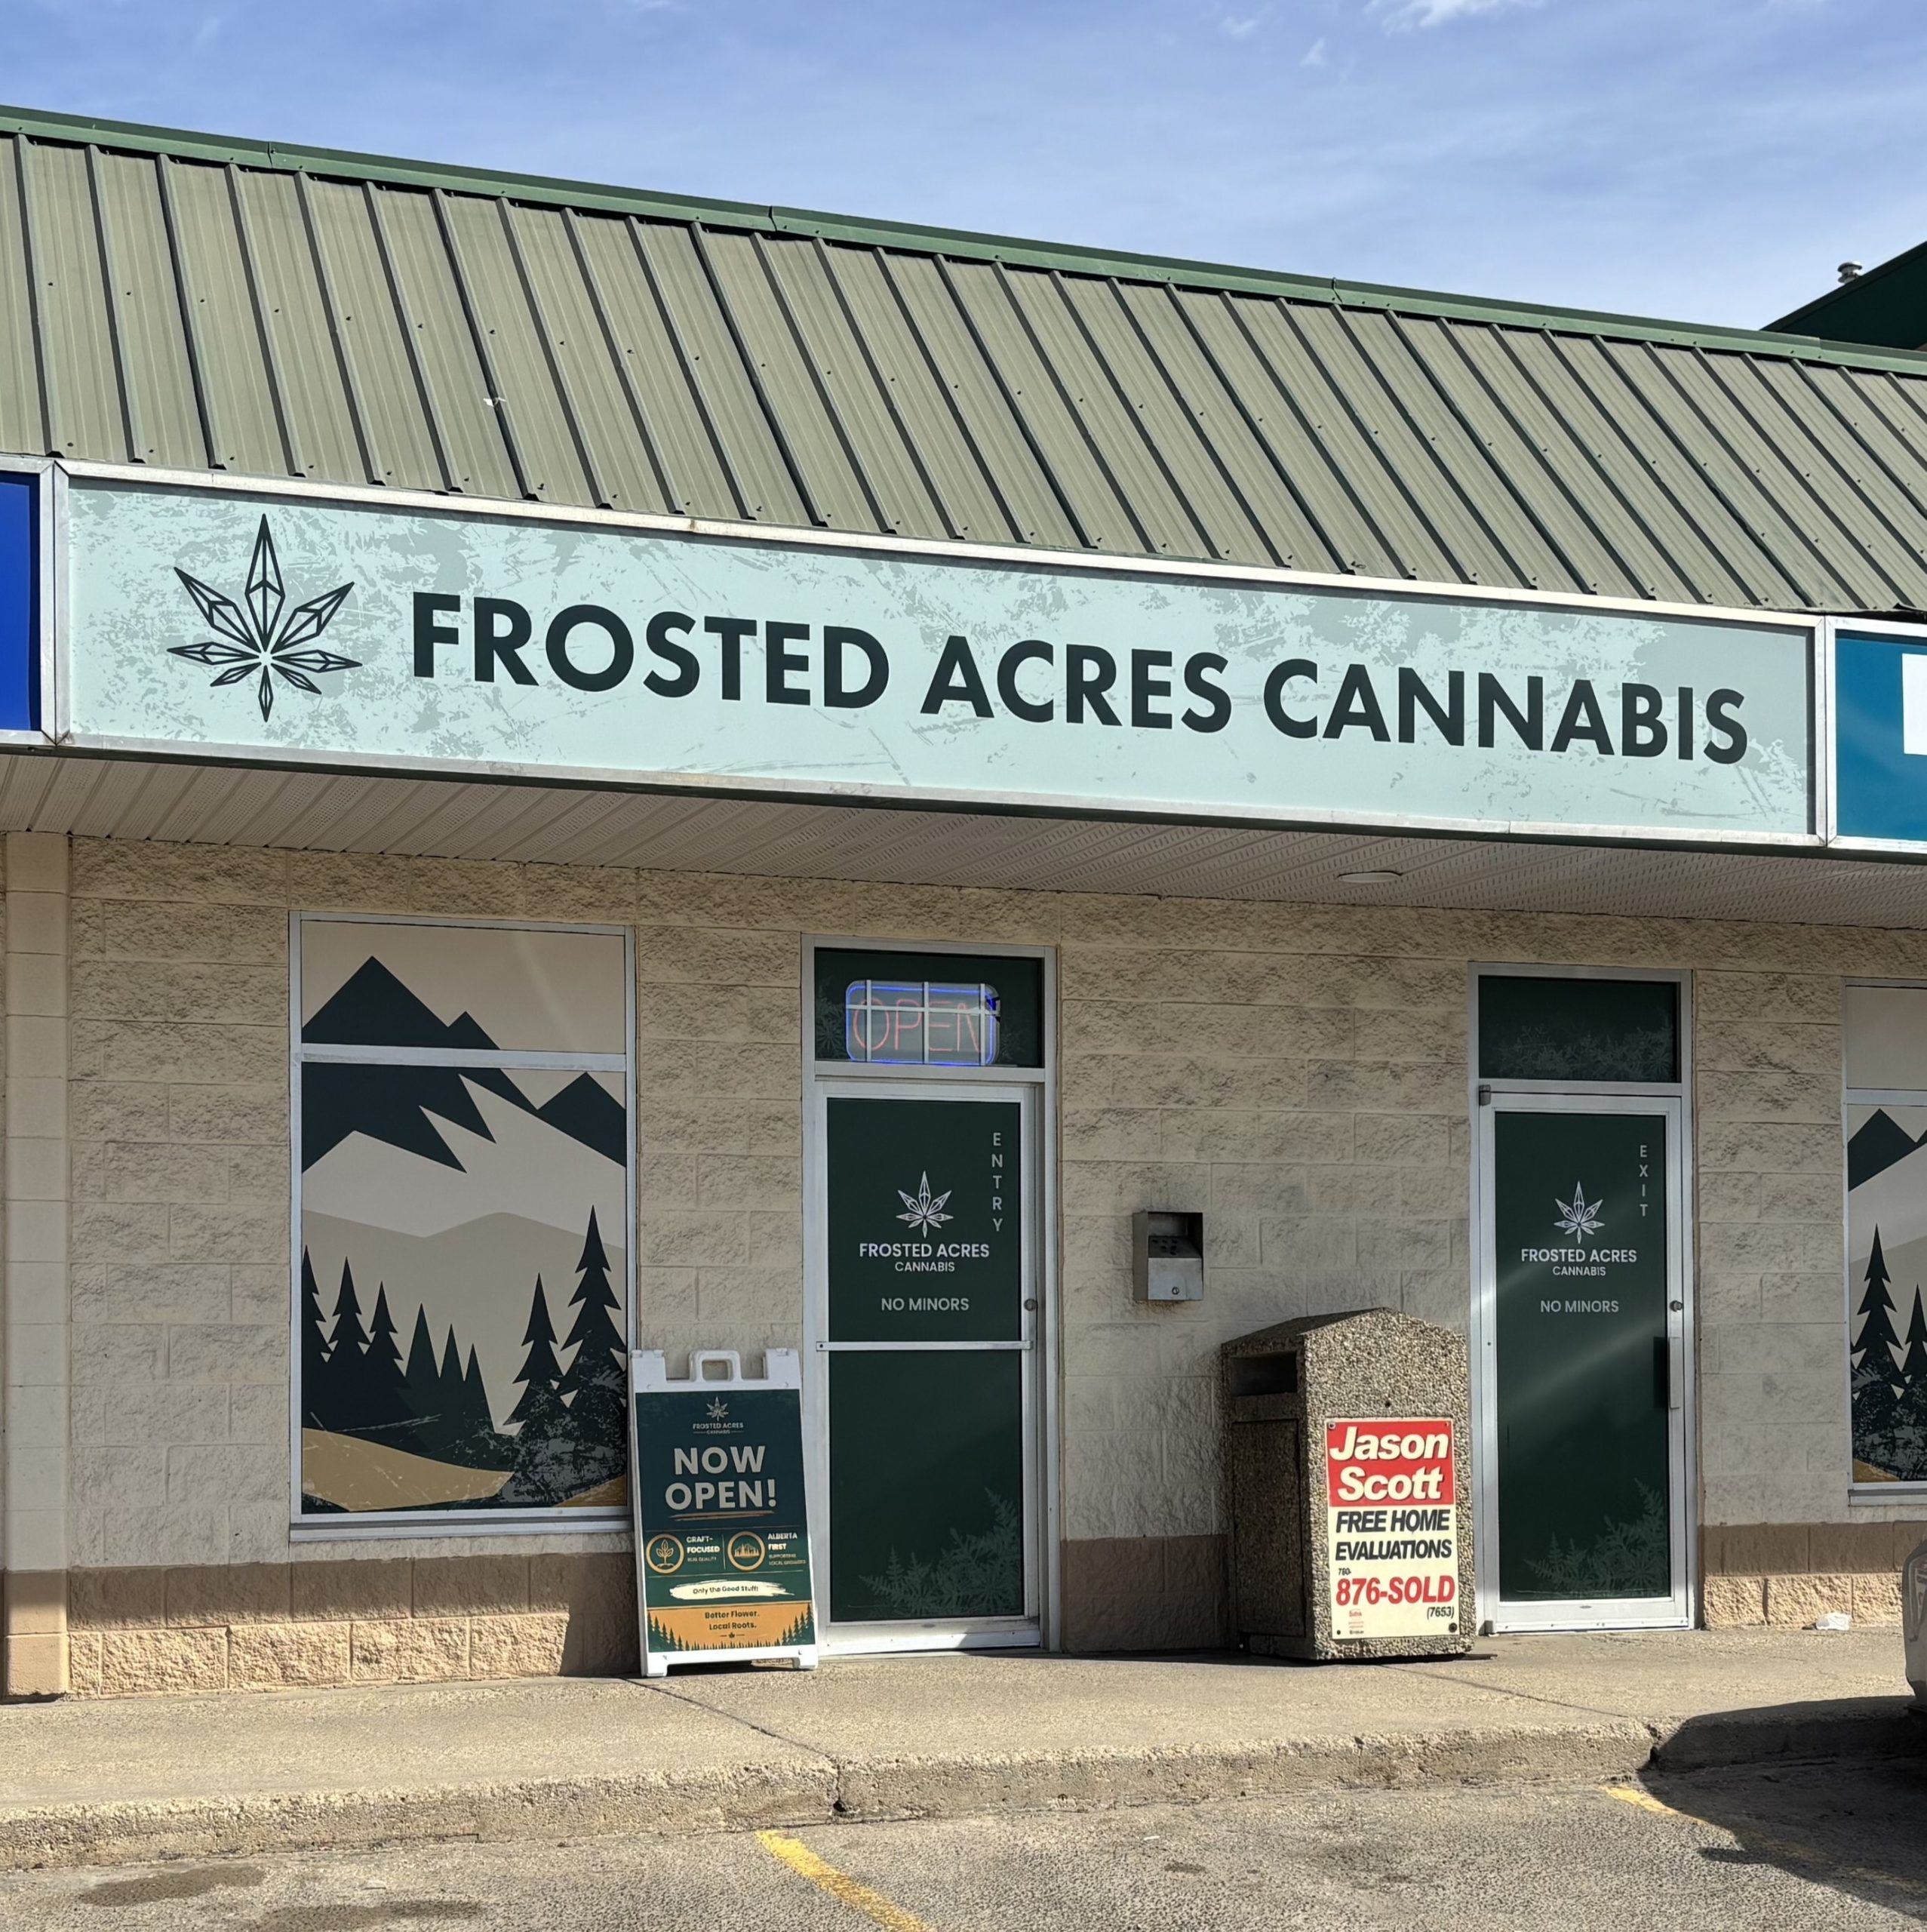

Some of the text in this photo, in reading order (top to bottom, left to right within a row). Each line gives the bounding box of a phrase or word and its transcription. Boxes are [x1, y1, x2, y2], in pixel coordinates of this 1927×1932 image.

[413, 592, 1747, 764] FROSTED ACRES CANNABIS
[853, 998, 982, 1053] OPEN
[991, 1132, 1003, 1232] ENTRY
[1639, 1145, 1648, 1217] EXIT
[859, 1243, 990, 1258] FROSTED ACRES
[1521, 1248, 1637, 1263] FROSTED ACRES
[895, 1261, 955, 1272] CANNABIS
[1552, 1266, 1606, 1276] CANNABIS
[881, 1297, 970, 1311] NO MINORS
[1541, 1300, 1619, 1313] NO MINORS
[1329, 1426, 1449, 1461] Jason
[674, 1445, 766, 1475] NOW
[1337, 1466, 1444, 1501] Scott
[665, 1478, 776, 1510] OPEN!
[1336, 1509, 1451, 1534] FREE HOME
[687, 1535, 713, 1543] CRAFT-
[767, 1532, 798, 1540] ALBERTA
[687, 1545, 721, 1554] FOCUSED
[768, 1543, 787, 1551] FIRST
[1335, 1539, 1452, 1561] EVALUATIONS
[1336, 1575, 1455, 1606] 876-SOLD
[730, 1610, 761, 1618] Flower.
[1427, 1606, 1455, 1620] (7653)
[709, 1621, 758, 1630] Local Roots.
